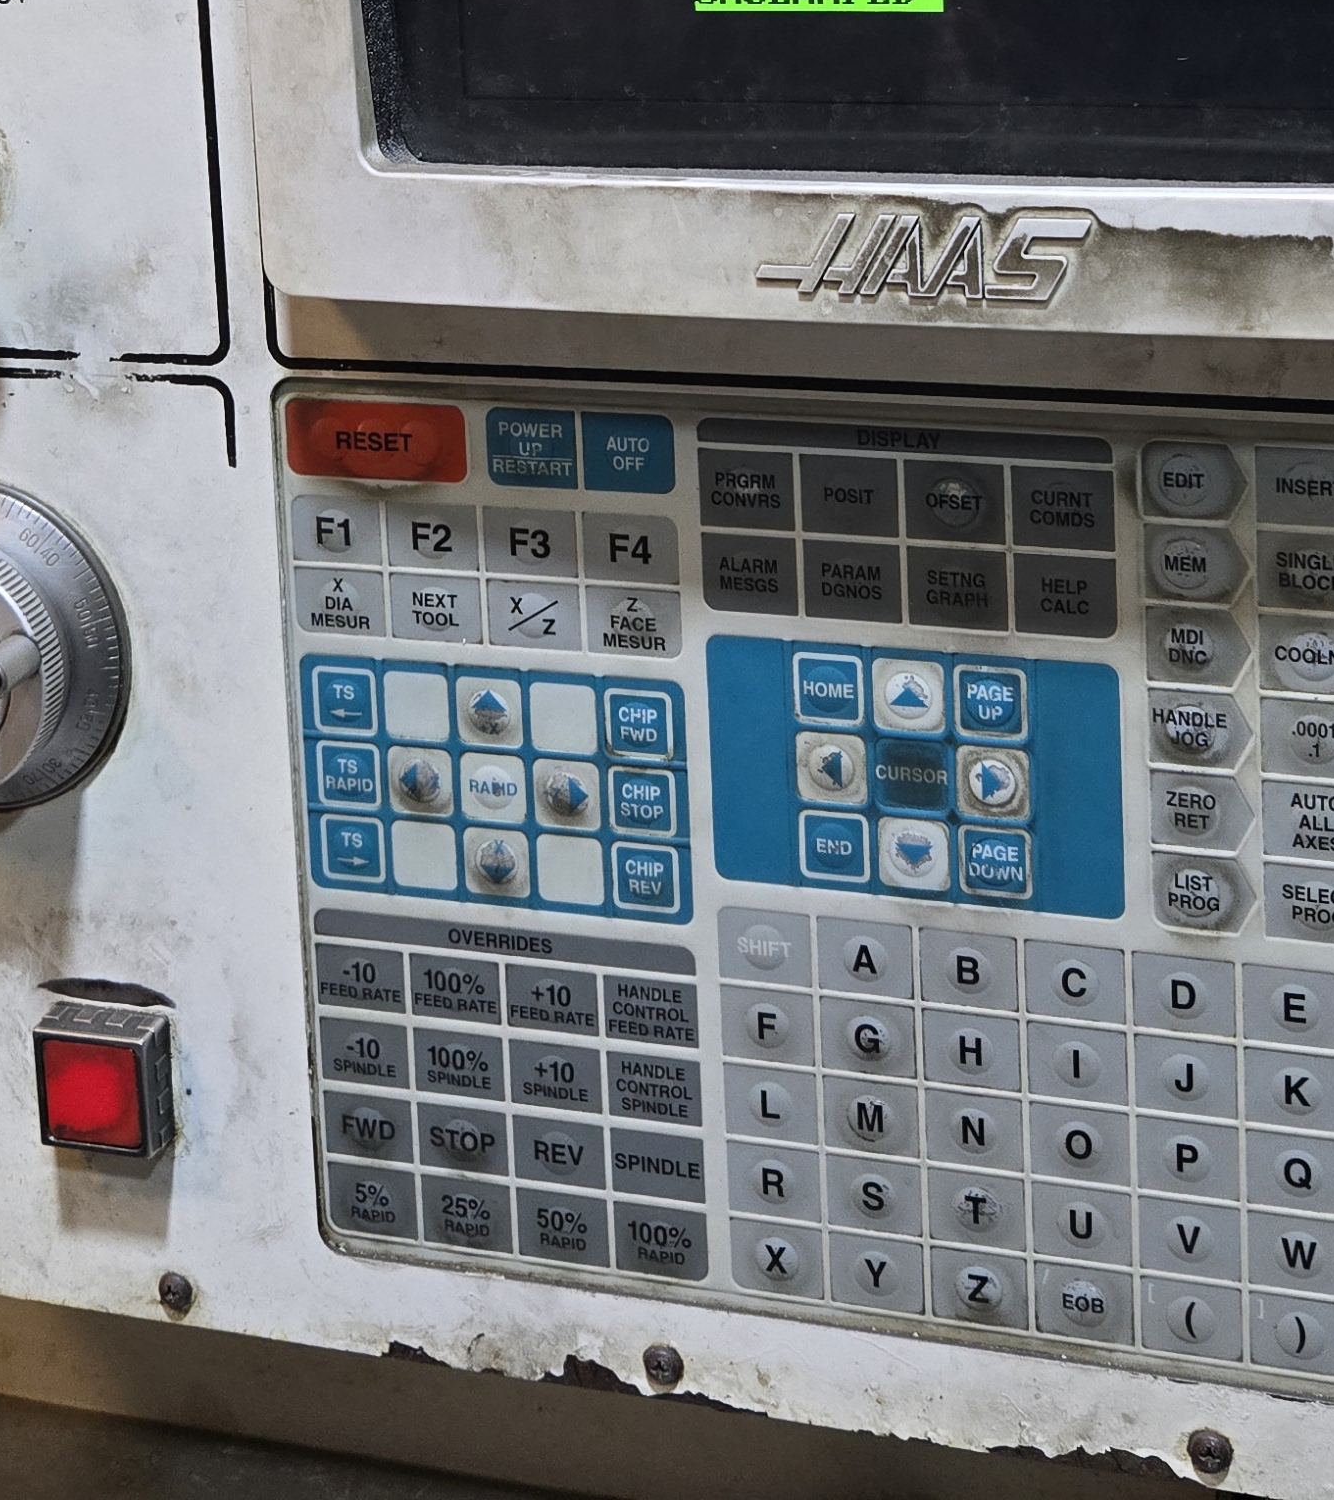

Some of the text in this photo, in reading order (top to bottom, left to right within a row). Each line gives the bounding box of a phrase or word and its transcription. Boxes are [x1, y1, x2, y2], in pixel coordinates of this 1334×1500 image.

[756, 213, 1092, 300] HAAS
[499, 421, 563, 439] POWER
[335, 431, 413, 453] RESET
[519, 441, 543, 456] UP
[607, 436, 650, 453] AUTO
[493, 458, 572, 477] RESTART
[613, 455, 644, 471] OFF
[925, 492, 982, 511] OFSET
[316, 517, 352, 547] F1
[411, 522, 452, 553] F2
[510, 527, 551, 559] F3
[609, 533, 651, 565] F4
[412, 592, 457, 609] NEXT
[414, 610, 459, 627] TOOL
[803, 680, 854, 700] HOME
[967, 684, 1014, 702] PAGE
[618, 707, 657, 723] CHIP
[876, 765, 948, 786] CURSOR
[448, 928, 553, 953] OVERRIDES
[852, 944, 877, 975] A
[540, 1234, 586, 1251] RAPID
[1282, 1238, 1317, 1270] W
